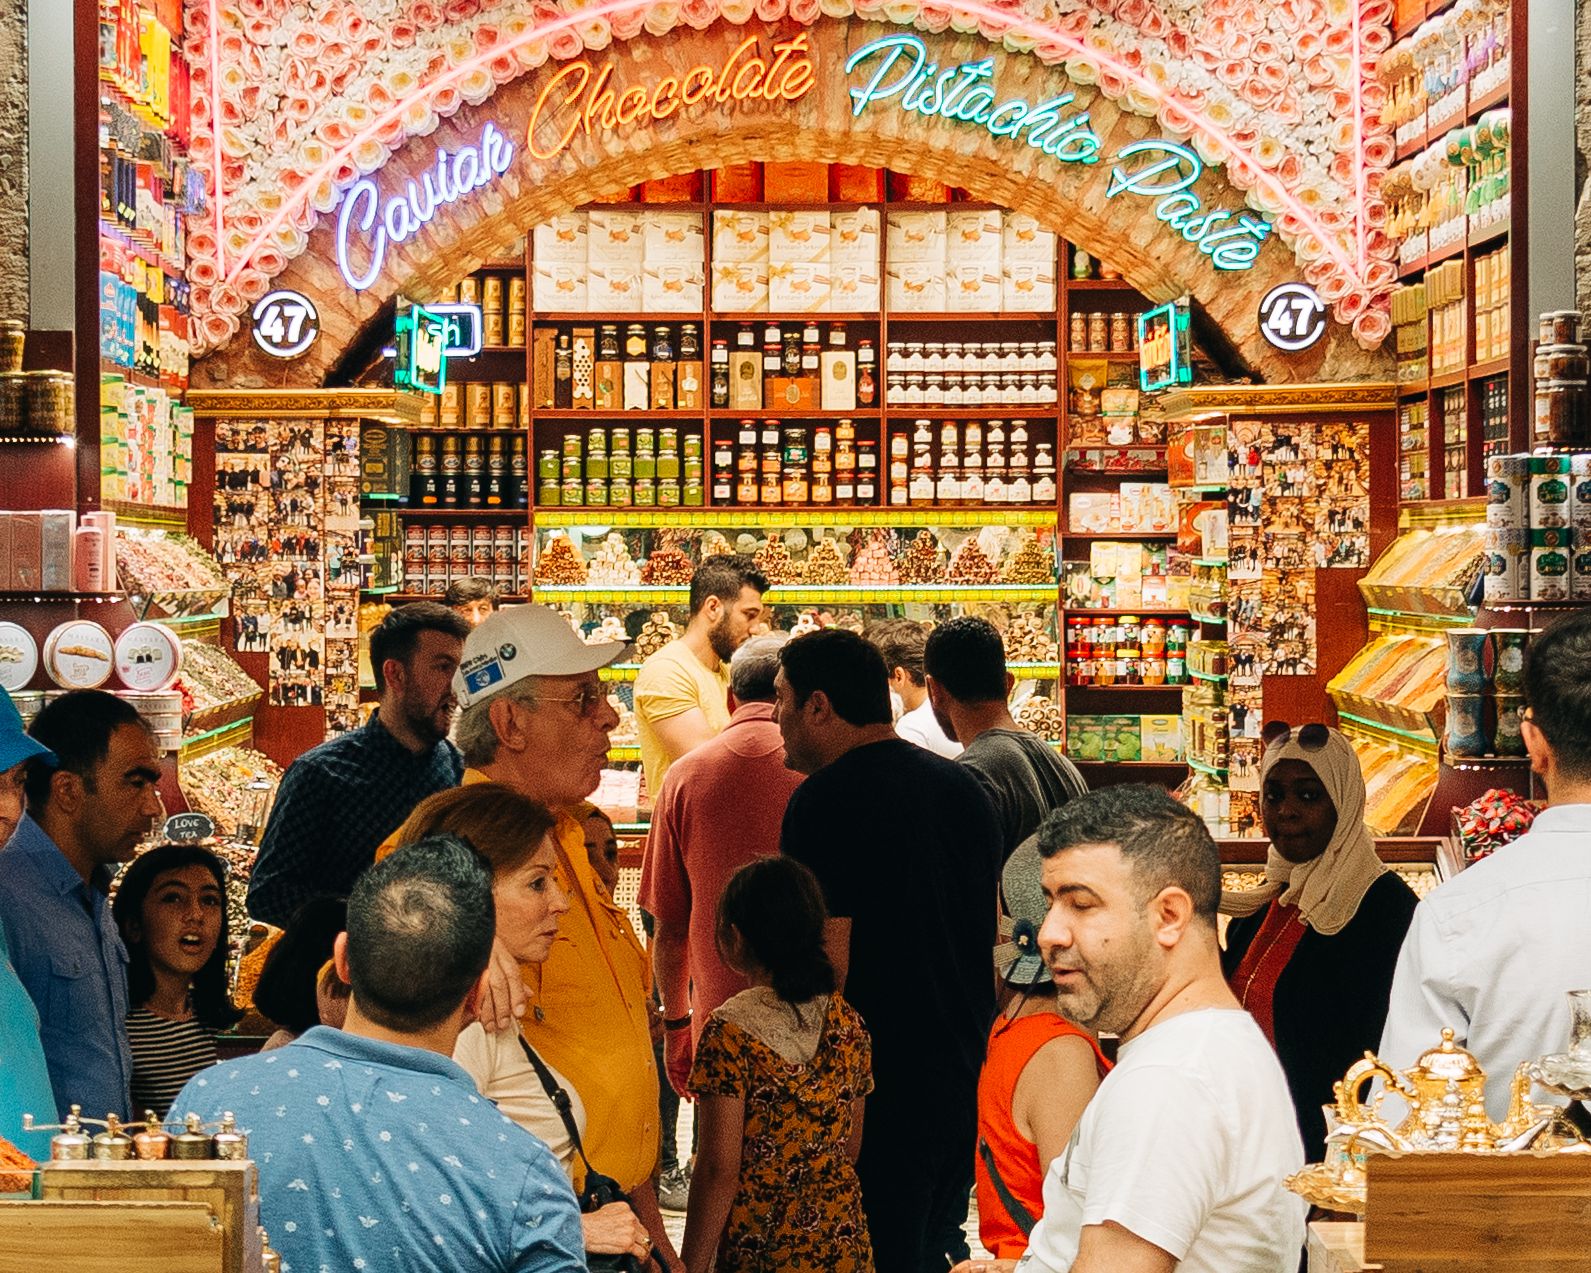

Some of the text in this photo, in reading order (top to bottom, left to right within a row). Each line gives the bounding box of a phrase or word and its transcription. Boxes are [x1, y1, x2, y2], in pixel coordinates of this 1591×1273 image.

[336, 31, 1273, 291] Caviar Chocolate Pistachio Paste
[259, 308, 308, 344] 47
[1266, 299, 1317, 335] 47
